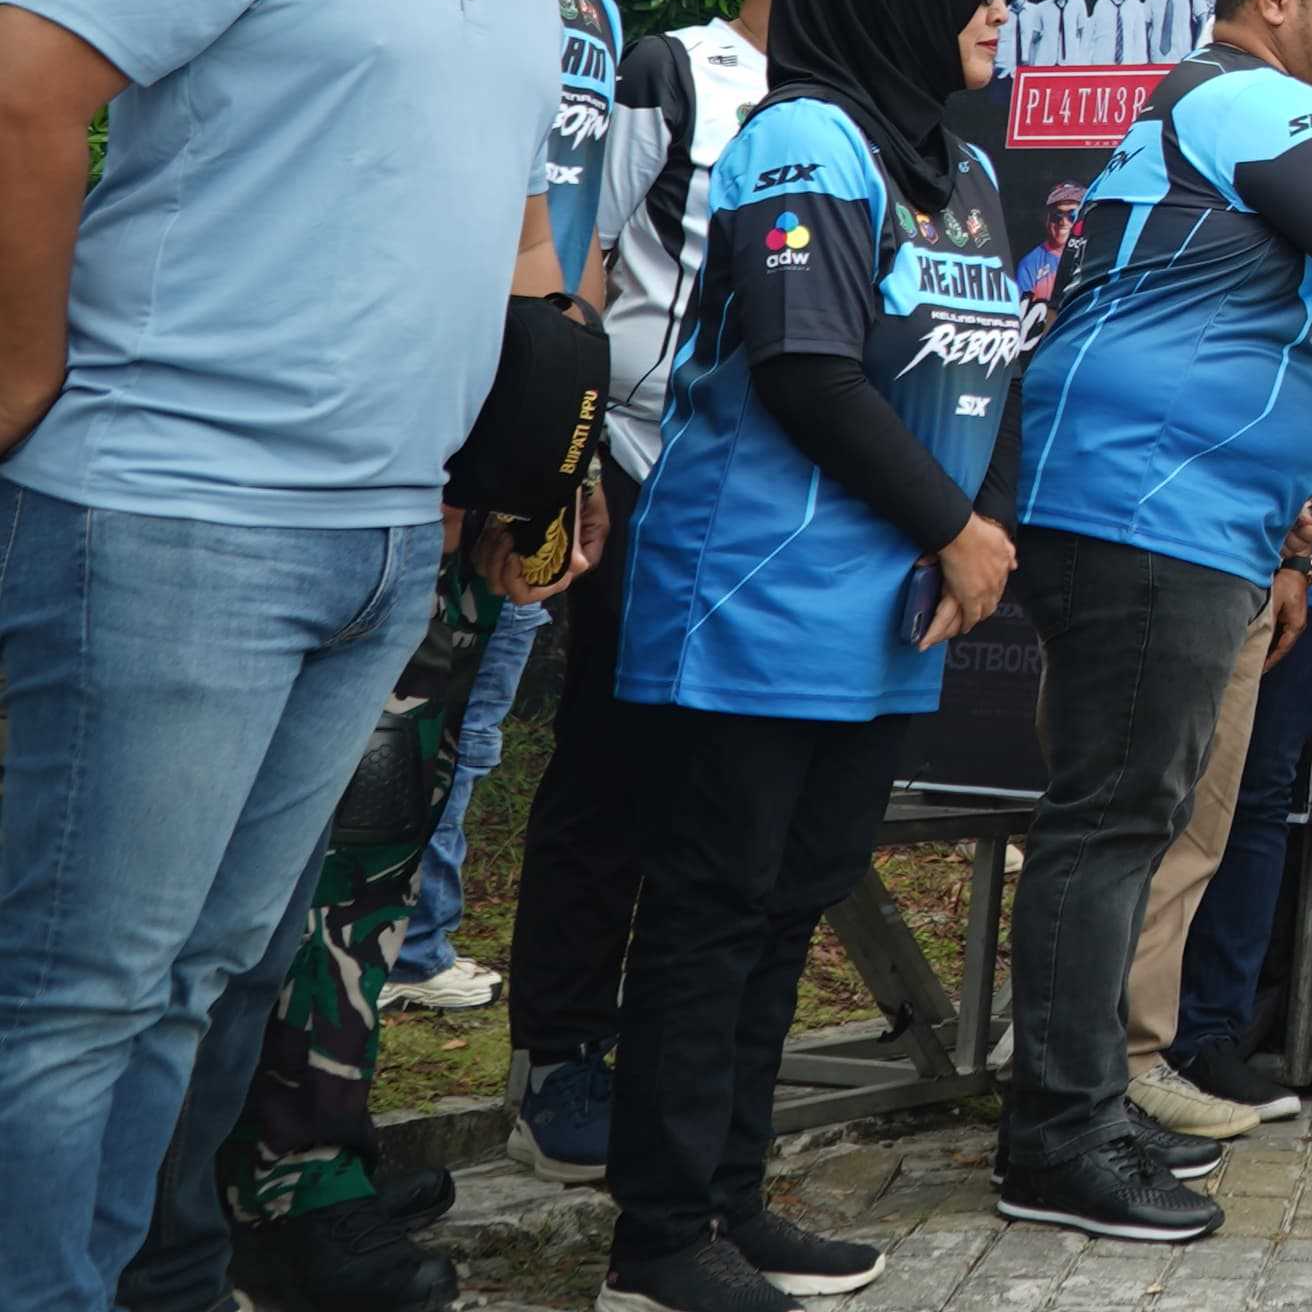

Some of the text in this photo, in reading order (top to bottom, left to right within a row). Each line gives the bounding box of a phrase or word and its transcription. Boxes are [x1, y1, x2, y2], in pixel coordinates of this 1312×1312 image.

[1025, 87, 1146, 125] PL4TM3R
[753, 163, 826, 193] SIX
[766, 249, 810, 268] adw
[956, 395, 991, 417] SIX
[559, 390, 598, 474] BUPATI PPU
